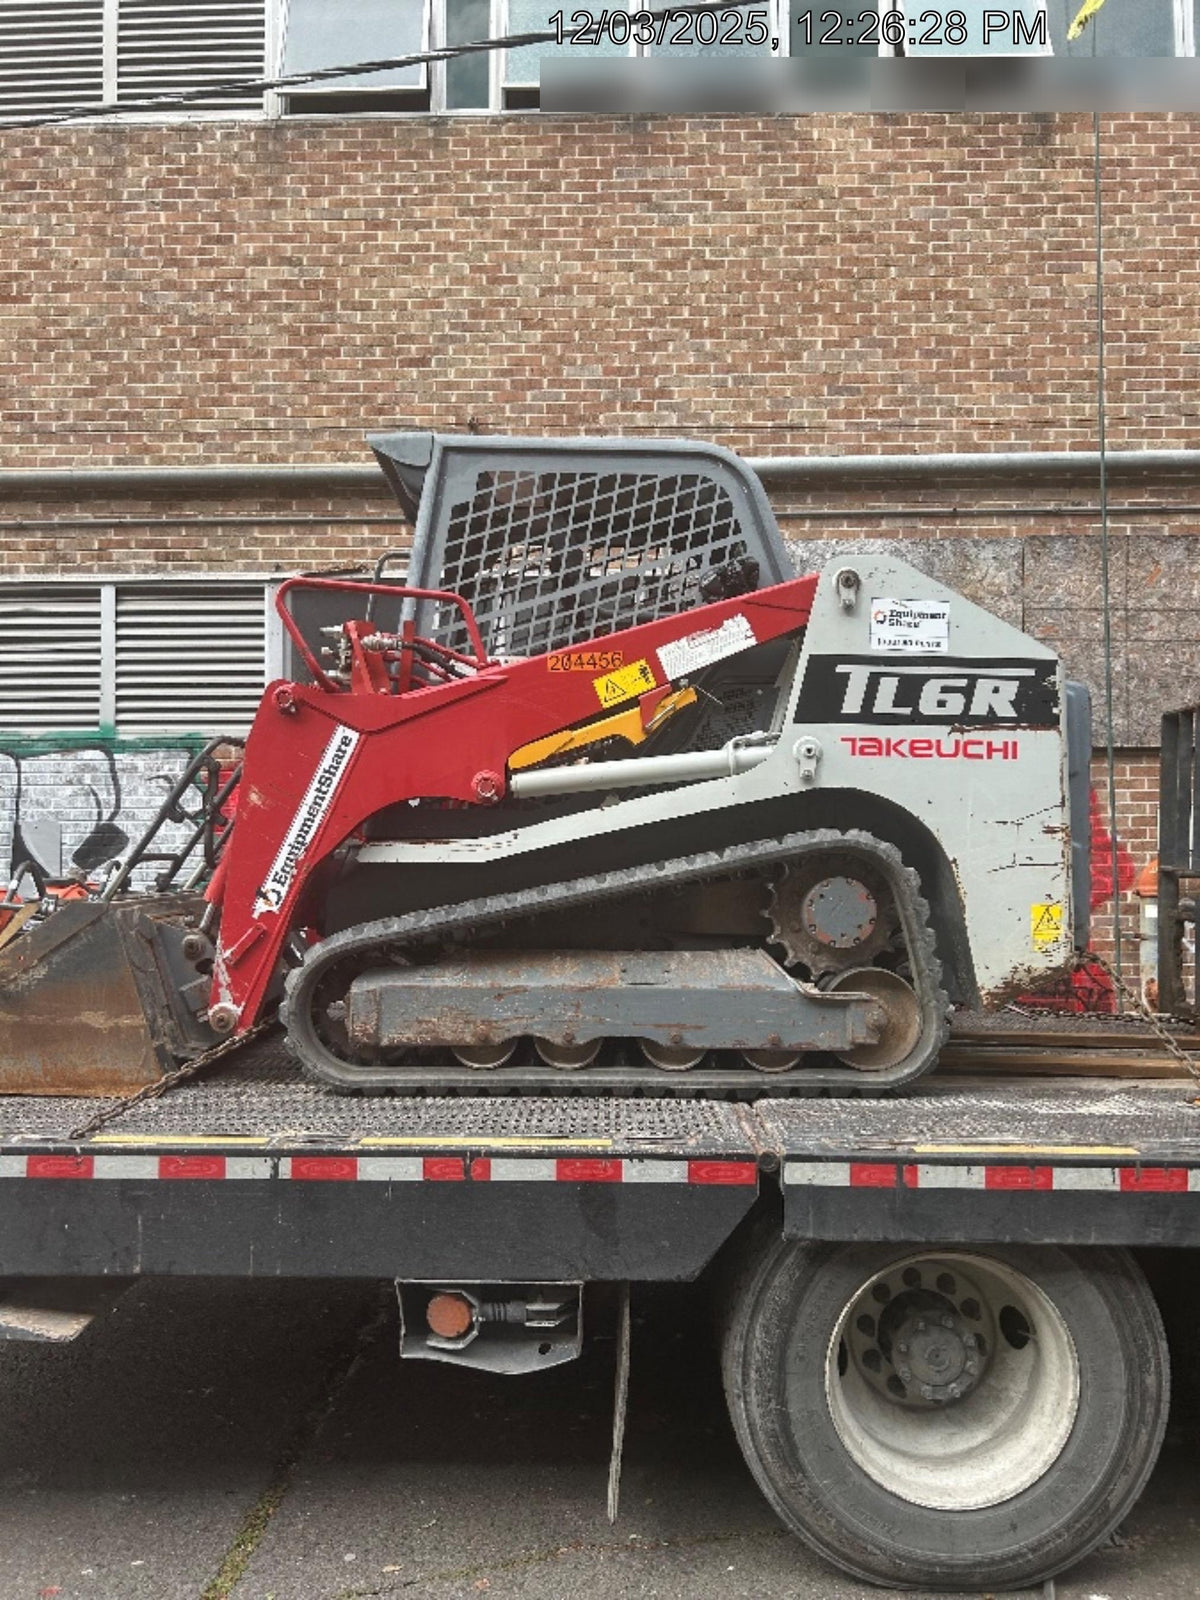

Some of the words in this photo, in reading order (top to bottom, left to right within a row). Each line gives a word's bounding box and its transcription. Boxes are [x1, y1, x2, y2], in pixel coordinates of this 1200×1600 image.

[888, 618, 920, 629] Shre
[549, 652, 623, 671] 204456
[835, 665, 1036, 718] TL6R
